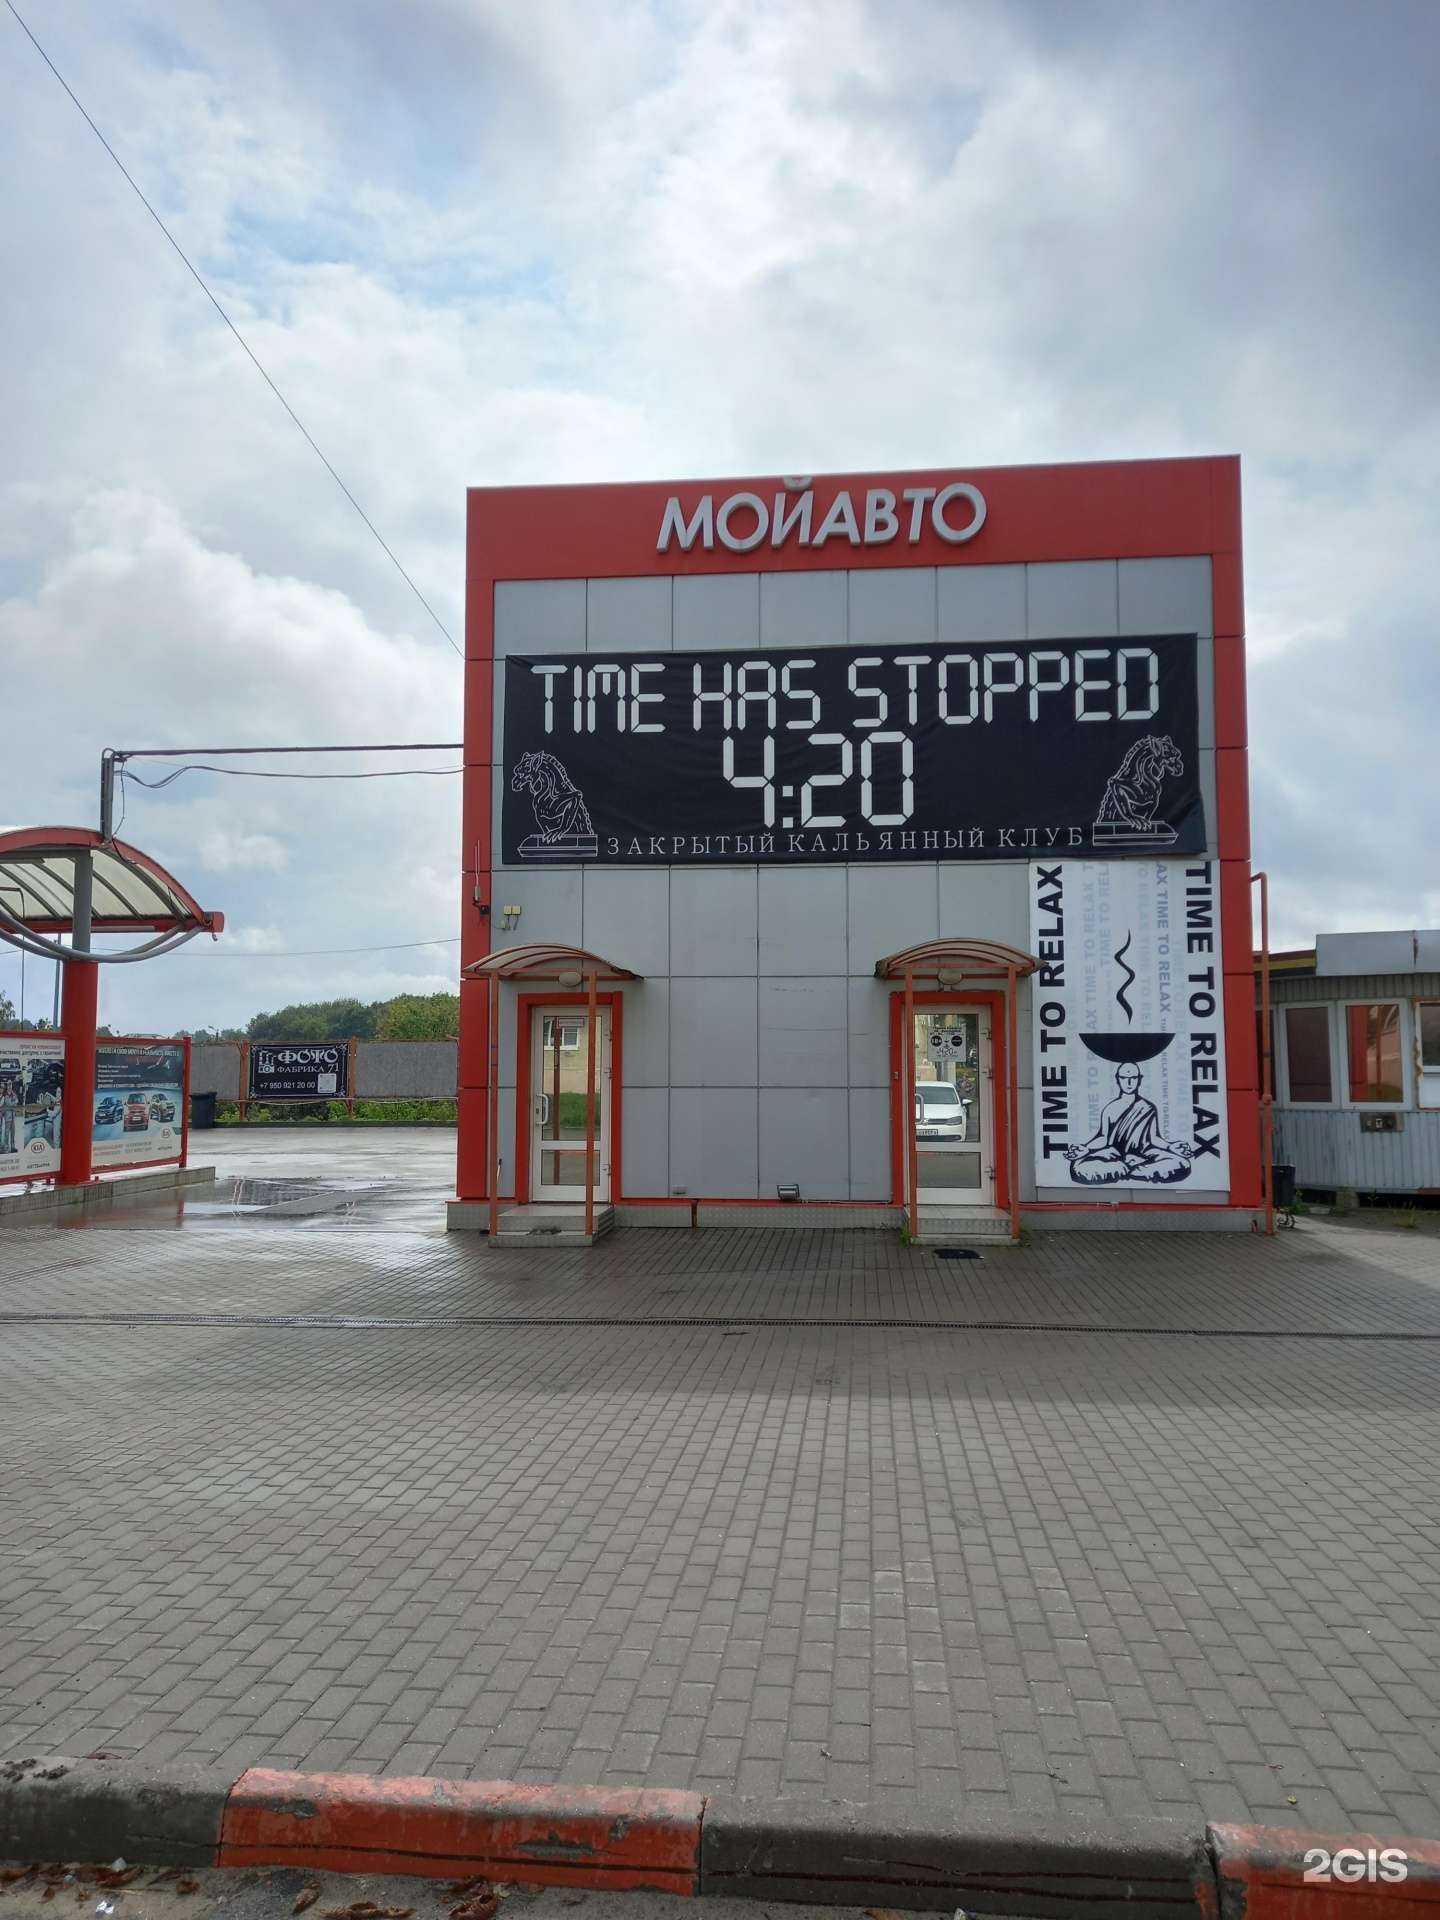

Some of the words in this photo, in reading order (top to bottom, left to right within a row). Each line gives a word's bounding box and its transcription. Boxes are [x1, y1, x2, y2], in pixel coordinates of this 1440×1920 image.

[656, 475, 987, 554] МОЙАВТО
[529, 662, 666, 735] TIME
[692, 659, 821, 732] HAS
[847, 647, 1160, 728] STOPPED
[722, 732, 914, 830] 4:20
[606, 830, 776, 857] ЗАКРЫТЫЙ
[787, 825, 986, 853] КАЛЬЯННЫЙ
[996, 823, 1085, 849] КЛУБ
[1037, 864, 1065, 988] RELAX
[1157, 890, 1169, 928] TIME
[1158, 934, 1170, 955] TO
[1185, 860, 1213, 955] TIME
[1158, 961, 1171, 1012] RELAX
[1188, 966, 1215, 1018] TO
[1039, 1001, 1066, 1054] TO
[1042, 1066, 1069, 1160] TIME
[1190, 1032, 1220, 1160] RELAX
